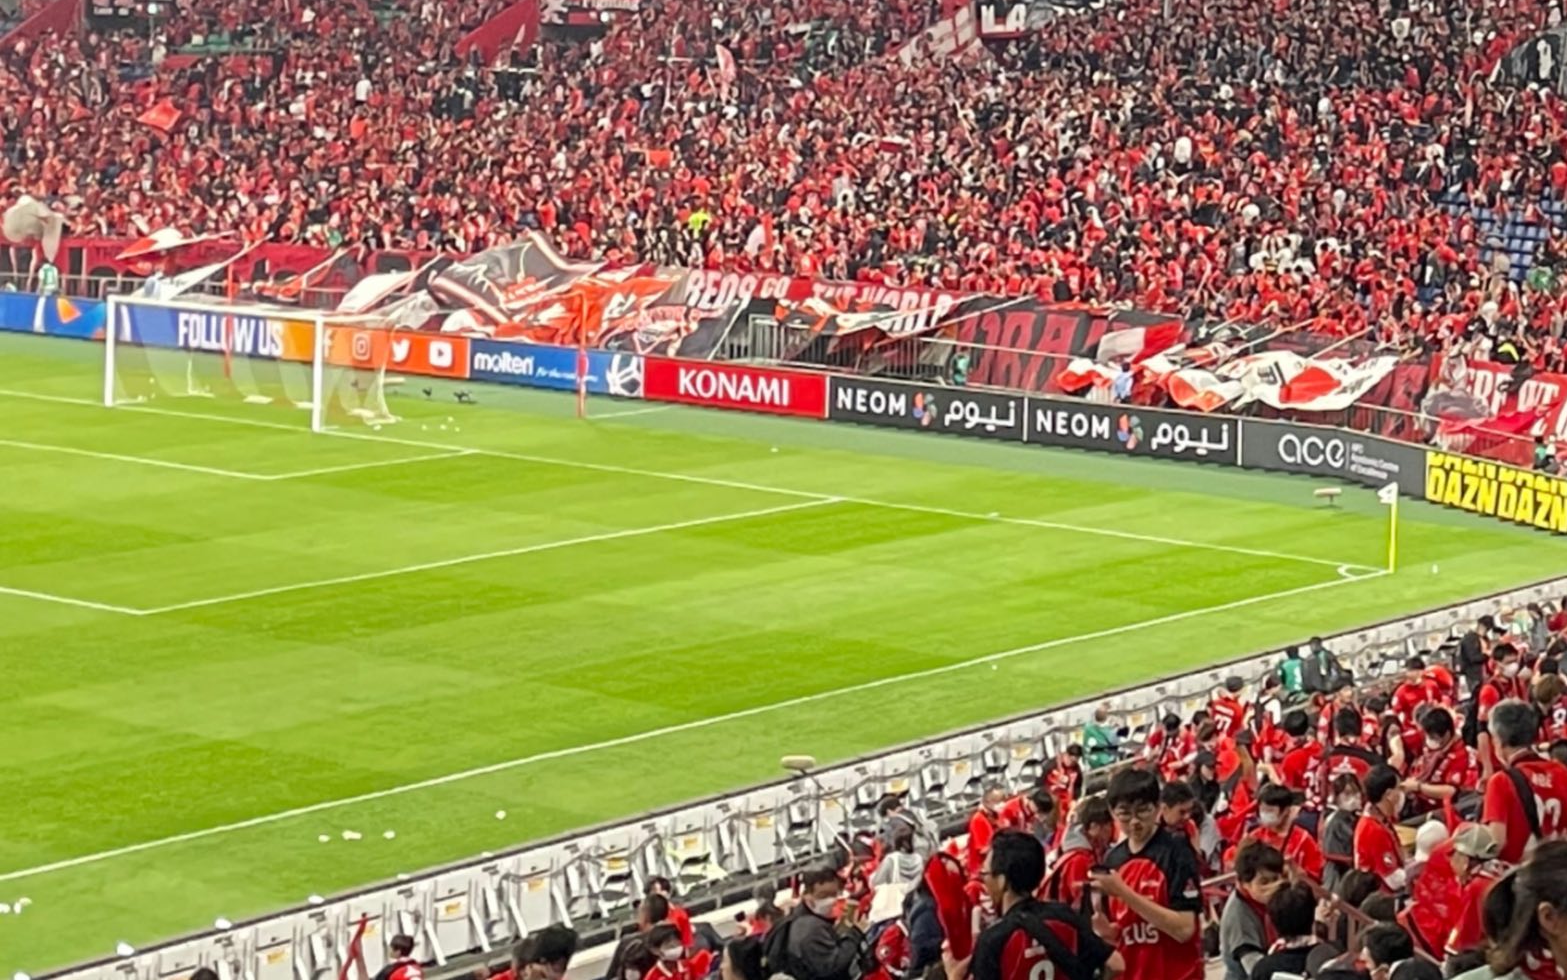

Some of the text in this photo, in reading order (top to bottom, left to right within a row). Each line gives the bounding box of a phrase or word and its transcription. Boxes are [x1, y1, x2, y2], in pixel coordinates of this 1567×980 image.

[760, 277, 791, 299] GO
[178, 311, 284, 357] FOLLOW US
[474, 352, 535, 376] molten
[678, 366, 790, 407] KONAMI
[836, 386, 906, 417] NEOM
[944, 399, 1016, 431] نيوم
[1035, 408, 1111, 440] NEOM
[1151, 422, 1230, 455] نيوم
[1278, 432, 1345, 469] ace
[1425, 467, 1499, 516] DAZN
